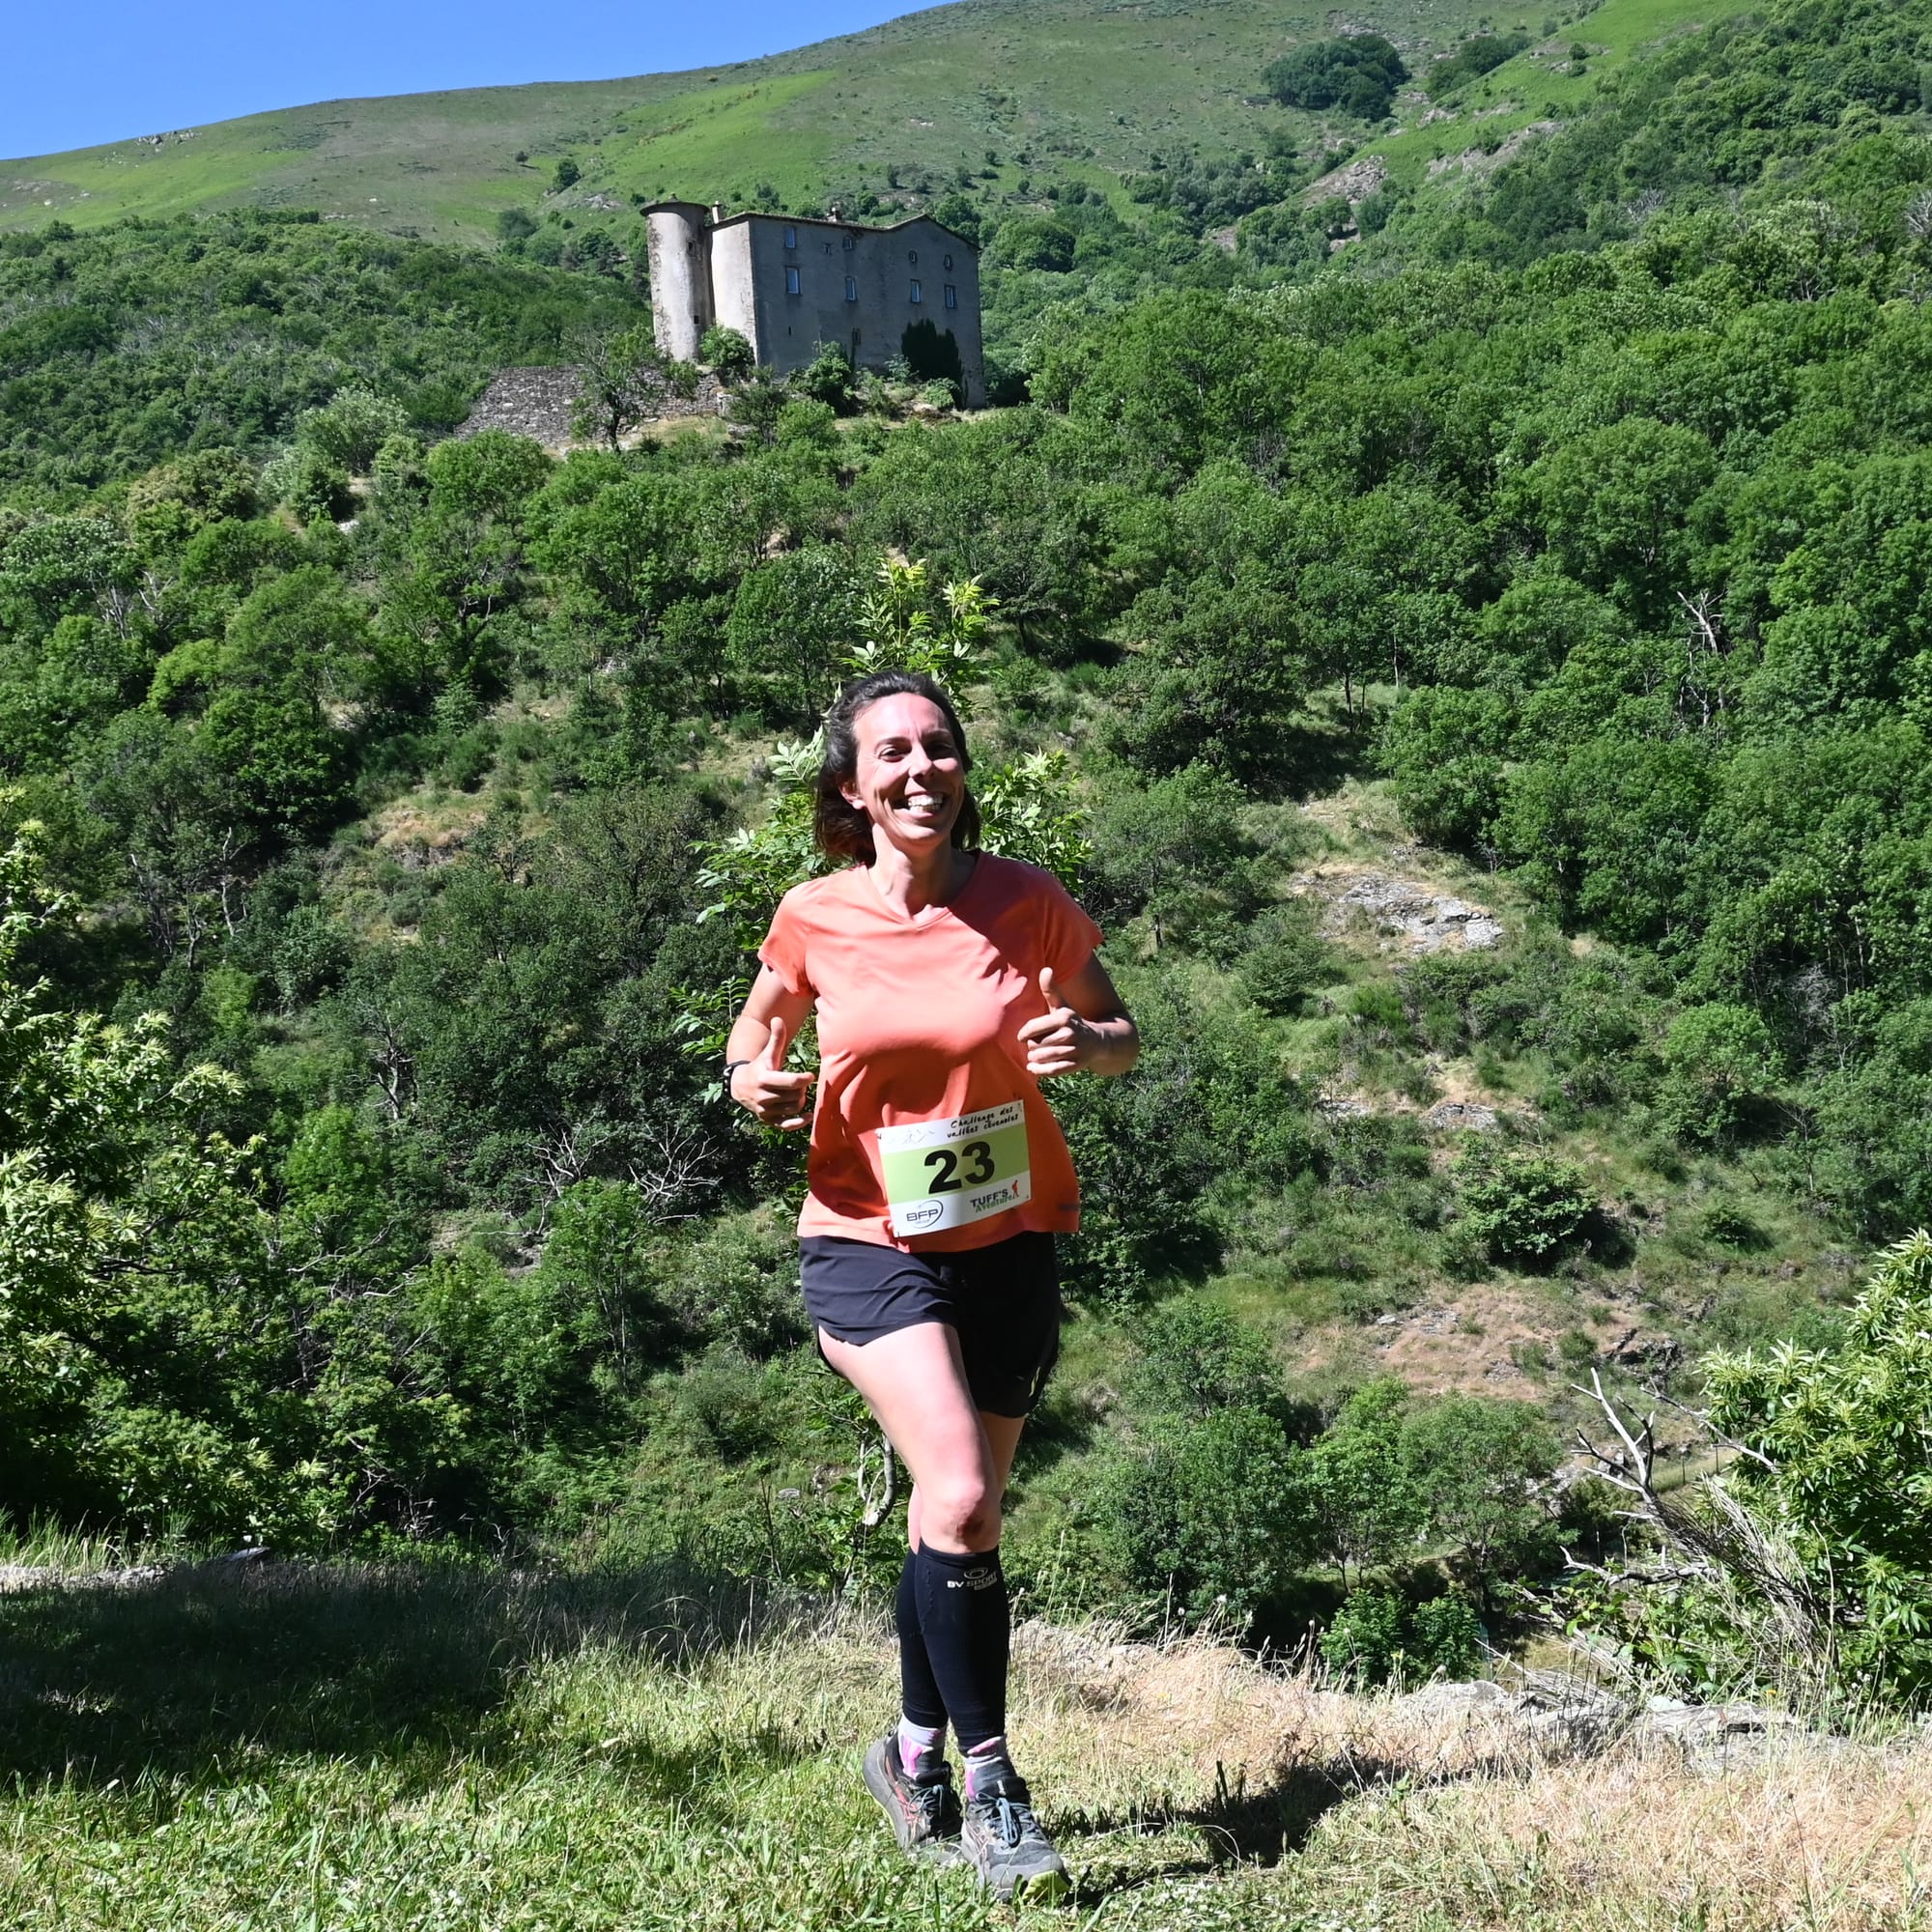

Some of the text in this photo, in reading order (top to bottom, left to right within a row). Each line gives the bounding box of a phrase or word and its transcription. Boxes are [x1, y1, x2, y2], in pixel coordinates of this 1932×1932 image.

[951, 1106, 1012, 1128] Challenge des
[924, 1141, 995, 1195] 23
[970, 1188, 1009, 1208] TUFF'S
[906, 1208, 939, 1222] BFP
